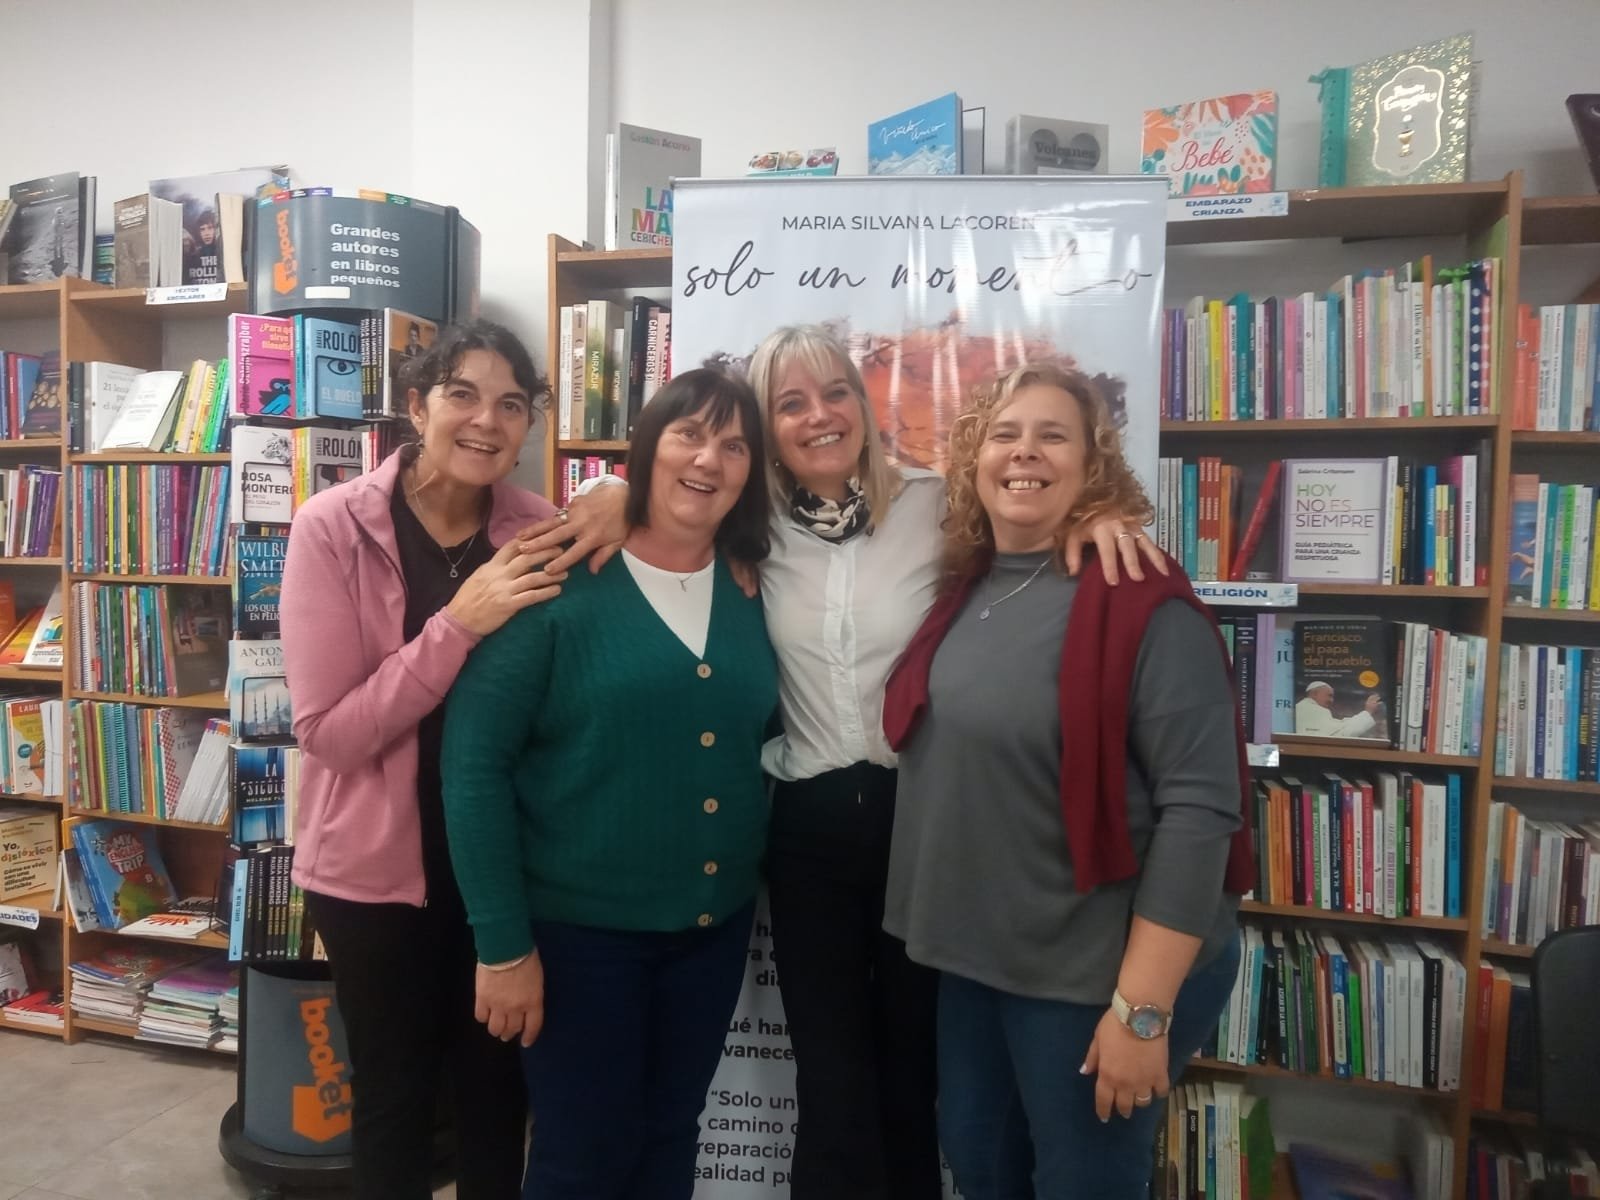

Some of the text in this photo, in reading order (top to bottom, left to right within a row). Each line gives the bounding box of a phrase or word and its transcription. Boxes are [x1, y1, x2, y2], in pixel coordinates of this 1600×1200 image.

[1171, 136, 1234, 172] Bebé
[1186, 198, 1252, 208] EMBARAZO
[1192, 208, 1244, 216] CRIANZA
[783, 216, 846, 230] MARIA
[850, 216, 934, 230] SILVANA
[330, 222, 400, 242] Grandes
[332, 241, 400, 258] autores
[330, 259, 400, 276] en libros
[683, 238, 1153, 298] solo un moeto
[330, 273, 400, 288] pequeños
[324, 330, 362, 354] ROLÓ
[646, 320, 658, 371] CARNICEROS
[590, 350, 600, 390] MIRAZUR
[241, 472, 272, 482] ROSA
[1297, 484, 1336, 498] HOY
[1296, 500, 1352, 513] NO ES
[1296, 514, 1375, 528] SIEMPRE
[1192, 586, 1268, 598] RELIGIÓN
[245, 604, 259, 612] LOS
[1304, 632, 1362, 642] Francisco
[1304, 643, 1350, 656] el papa
[1304, 655, 1372, 668] del pueblo
[266, 763, 278, 777] LA
[0, 846, 54, 862] disléxico
[2, 843, 20, 852] Yo,
[115, 854, 144, 874] TRIP
[728, 1018, 751, 1033] ué
[711, 1090, 796, 1110] “Solo un
[708, 1116, 784, 1134] camino
